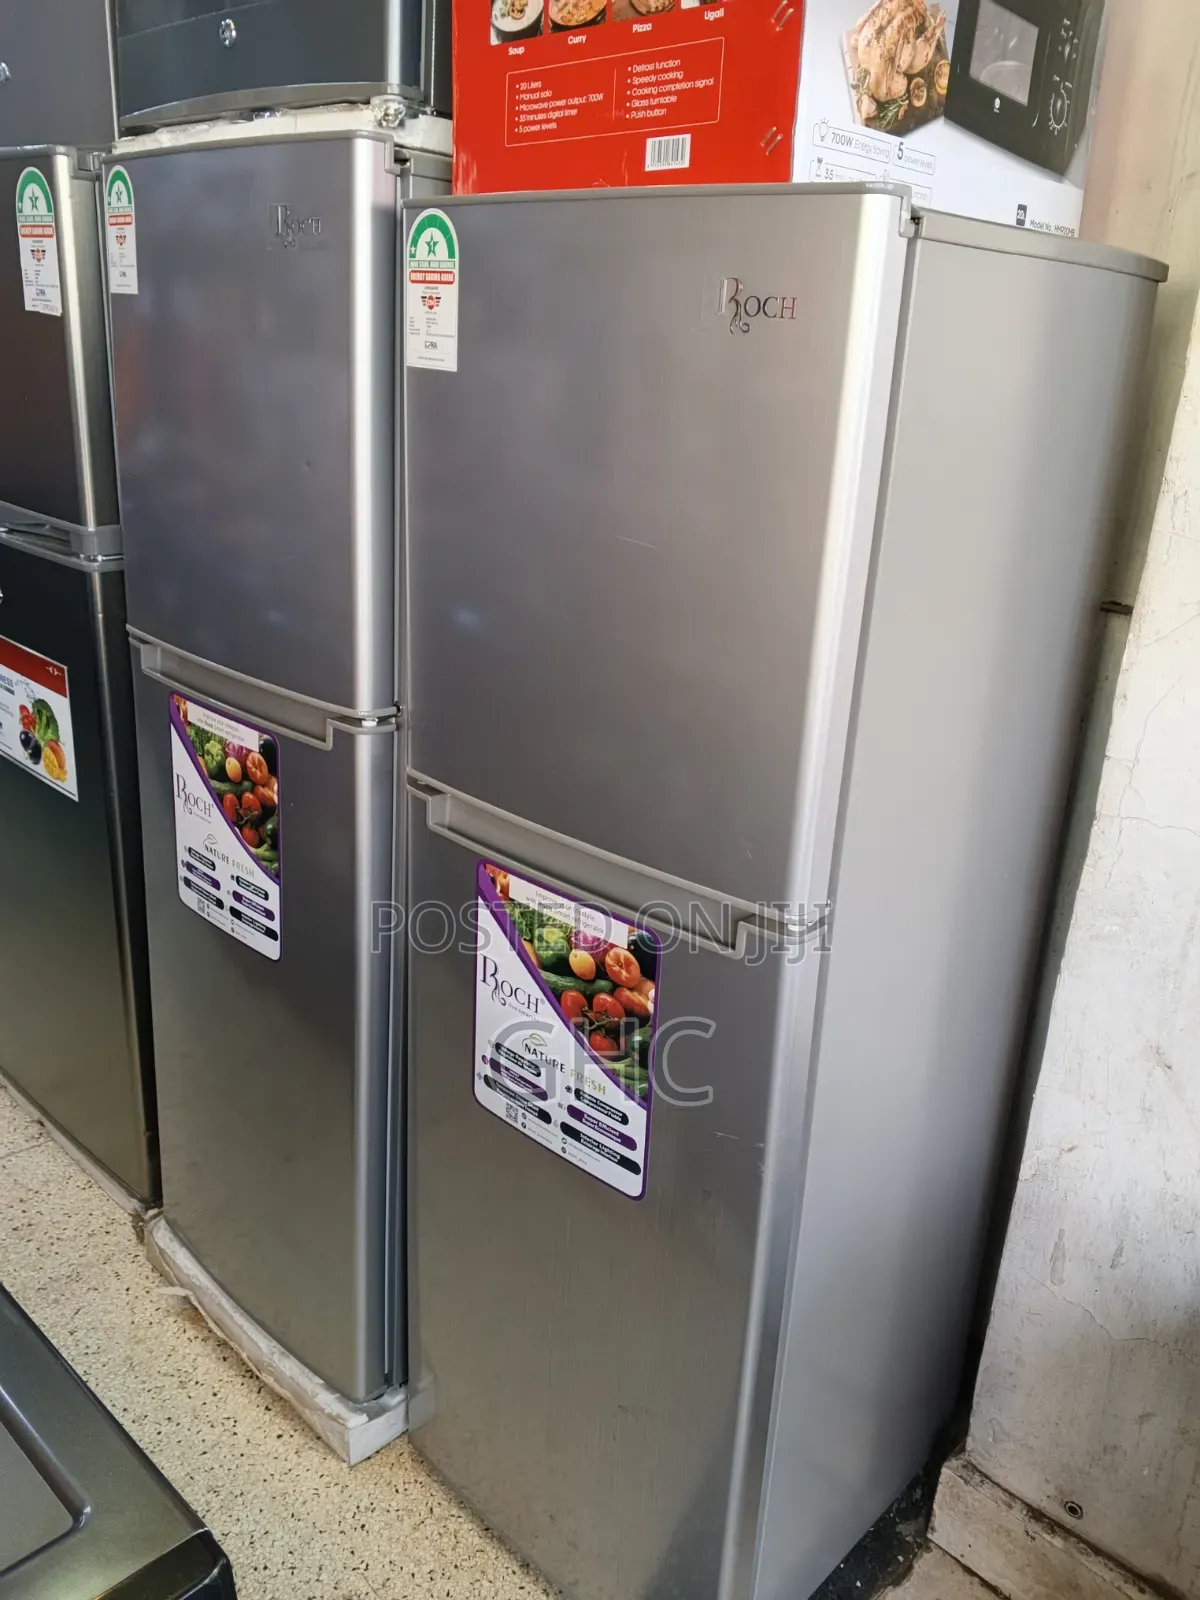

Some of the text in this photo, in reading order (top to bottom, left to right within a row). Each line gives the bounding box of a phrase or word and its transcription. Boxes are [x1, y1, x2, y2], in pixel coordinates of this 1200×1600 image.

[704, 8, 724, 21] Ugali
[632, 22, 652, 33] Pizza
[567, 34, 587, 45] Curry
[508, 46, 525, 56] Soup
[632, 59, 680, 73] Defrost function
[632, 70, 684, 85] Speedy cooking
[632, 77, 714, 96] Cooking completion signal
[520, 90, 552, 100] Manual solo
[520, 101, 548, 111] Microwave
[549, 99, 566, 108] power
[587, 92, 604, 102] 700W
[631, 95, 677, 108] Glass turntable
[548, 110, 564, 120] digital
[564, 108, 578, 116] timer
[630, 108, 666, 119] Push button
[523, 124, 540, 133] power
[541, 122, 557, 130] levels
[831, 132, 854, 147] 700W
[854, 139, 872, 154] Energy
[897, 142, 933, 170] 5 power levels
[824, 168, 834, 180] 35
[1030, 220, 1045, 230] Model
[204, 844, 230, 865] NATURE
[232, 860, 254, 878] FRESH
[524, 1044, 566, 1074] NATURE
[570, 1068, 606, 1095] FRESH
[584, 1114, 620, 1136] Super Efficient
[599, 1142, 620, 1160] Lighting
